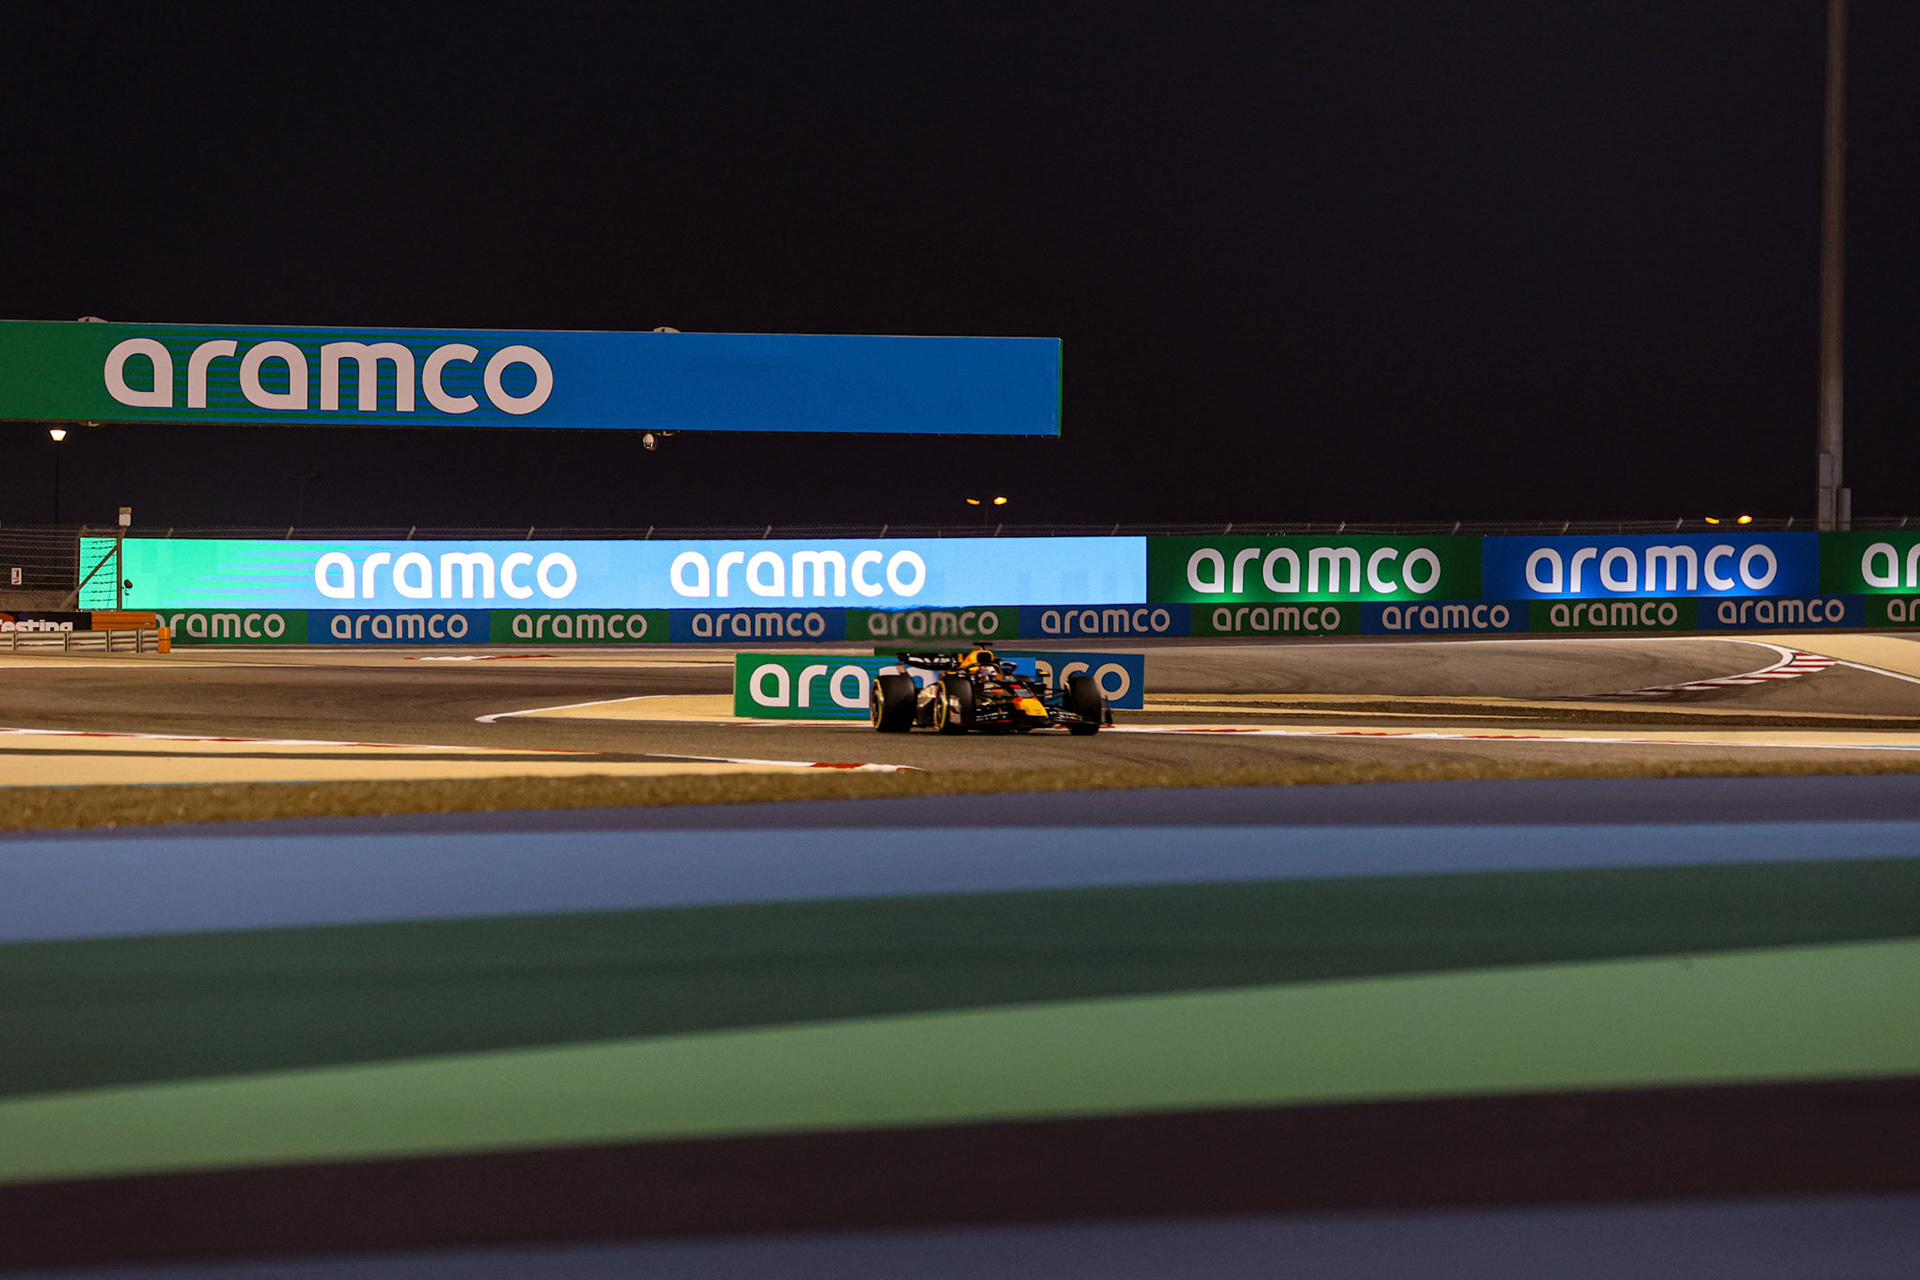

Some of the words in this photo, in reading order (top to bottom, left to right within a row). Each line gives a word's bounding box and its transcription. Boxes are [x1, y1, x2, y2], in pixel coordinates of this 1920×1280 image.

[104, 338, 553, 414] aramco
[315, 551, 577, 600] aramco
[670, 550, 927, 598] aramco
[1187, 547, 1440, 594] aramco
[1525, 544, 1777, 593] aramco
[692, 612, 826, 637] aramco
[868, 610, 999, 636] aramco
[1041, 609, 1170, 635] aramco
[1213, 606, 1340, 632] aramco
[1382, 605, 1509, 629] aramco
[1550, 602, 1677, 627] aramco
[1718, 599, 1845, 624] aramco
[331, 614, 468, 639] aramco
[513, 614, 648, 638] aramco
